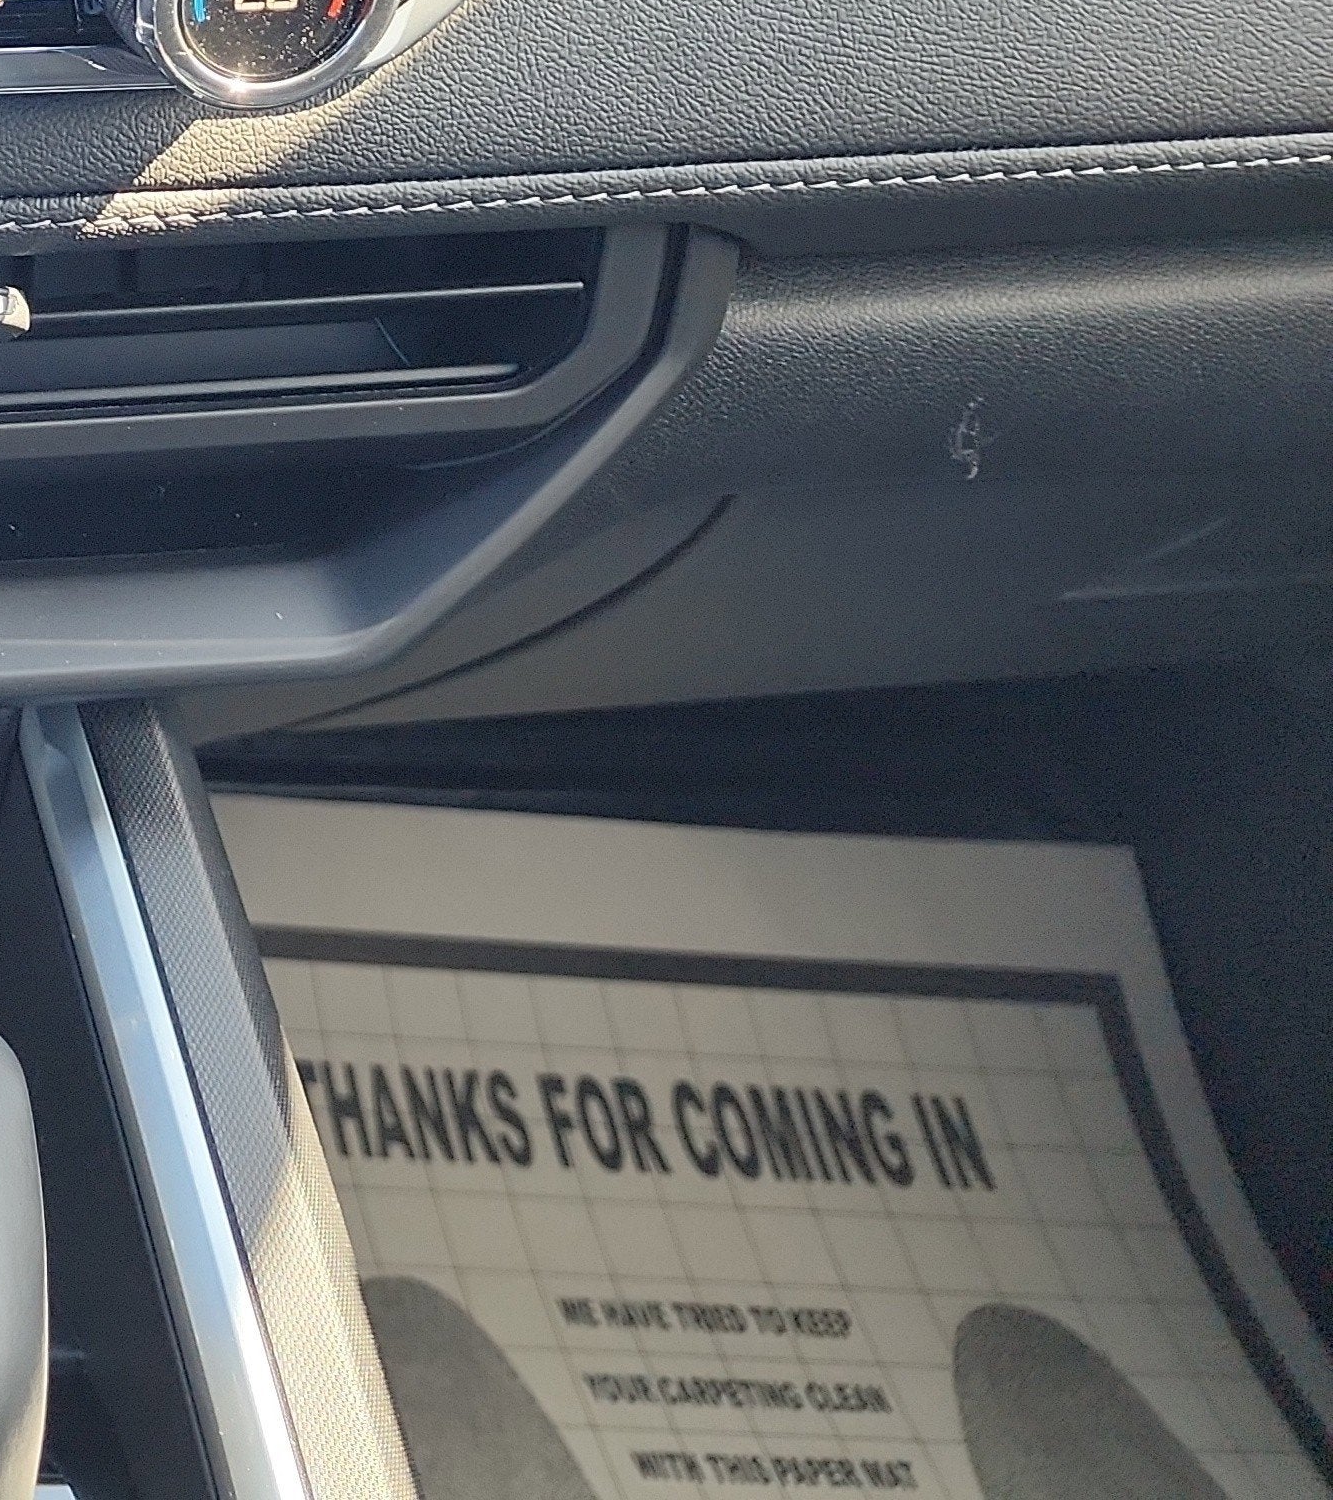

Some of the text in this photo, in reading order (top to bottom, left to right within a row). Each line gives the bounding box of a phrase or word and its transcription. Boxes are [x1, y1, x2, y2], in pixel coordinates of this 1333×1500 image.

[296, 1059, 997, 1193] HANKS FOR COMING IN
[600, 1300, 671, 1331] HAVE
[671, 1301, 748, 1334] TRIED
[747, 1304, 787, 1337] TO
[786, 1306, 853, 1339] KEEP
[583, 1371, 893, 1414] YOUR CARPETING CLEAN
[631, 1449, 920, 1491] WITH THIS PAPER MAT
